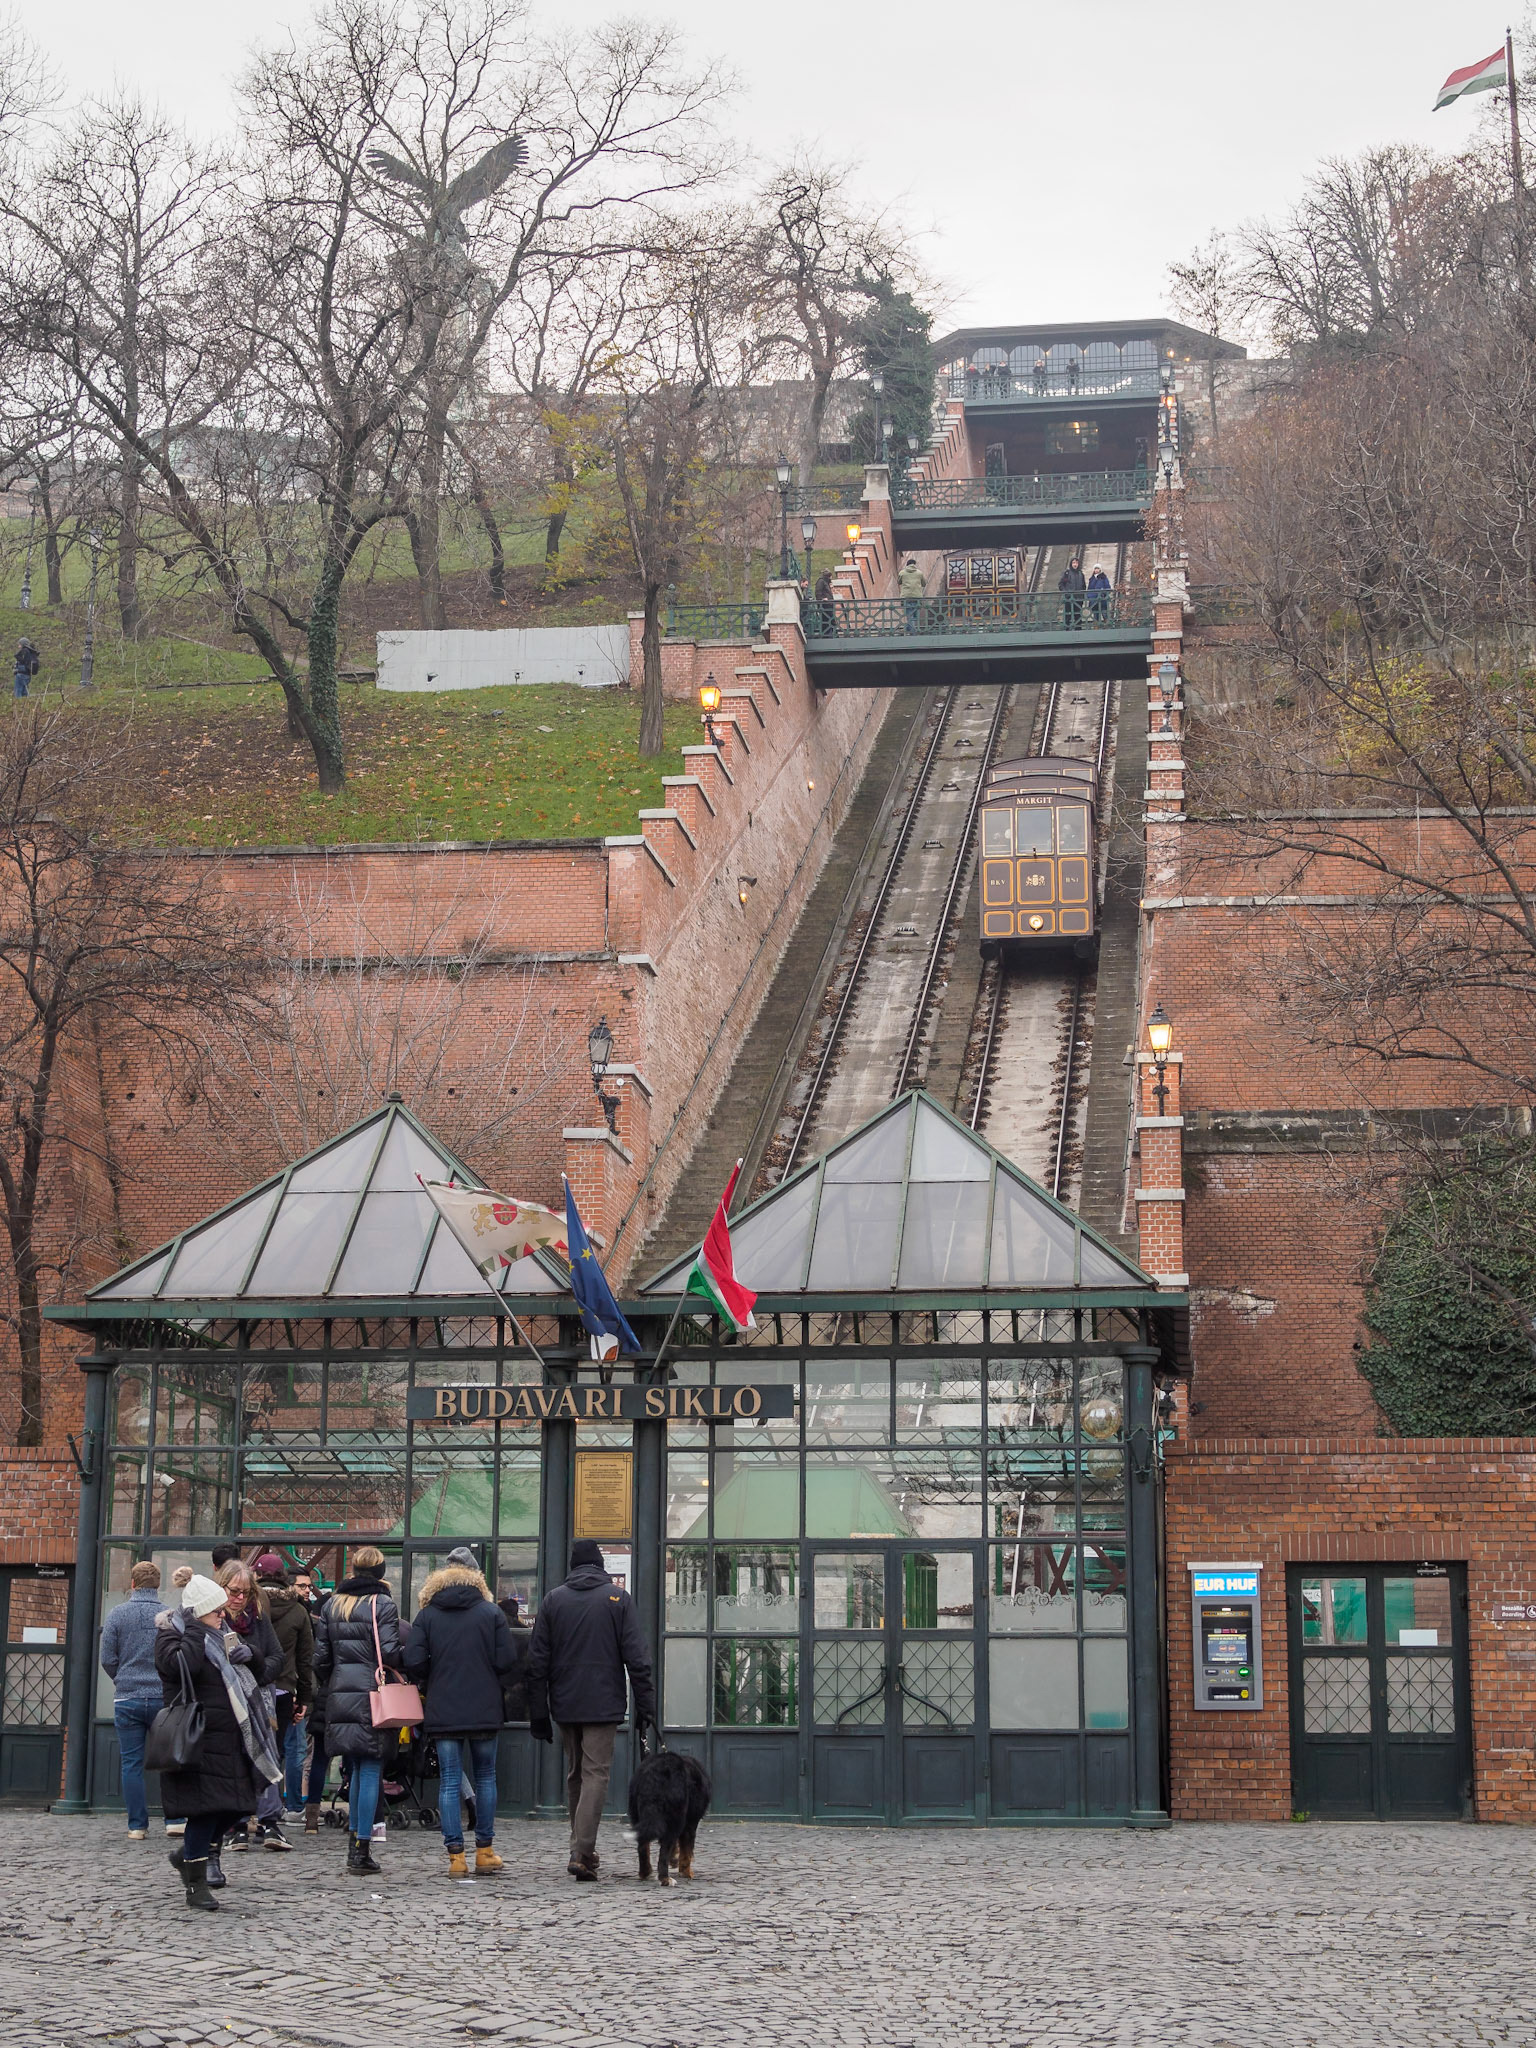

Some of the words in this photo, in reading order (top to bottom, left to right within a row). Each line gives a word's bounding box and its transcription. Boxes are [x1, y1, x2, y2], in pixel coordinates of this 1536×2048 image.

[433, 1385, 624, 1418] BUDAVÁRI
[645, 1384, 762, 1417] SIKLÓ
[1194, 1578, 1225, 1591] EUR
[1226, 1578, 1257, 1590] HUF
[1501, 1611, 1526, 1619] Boarding
